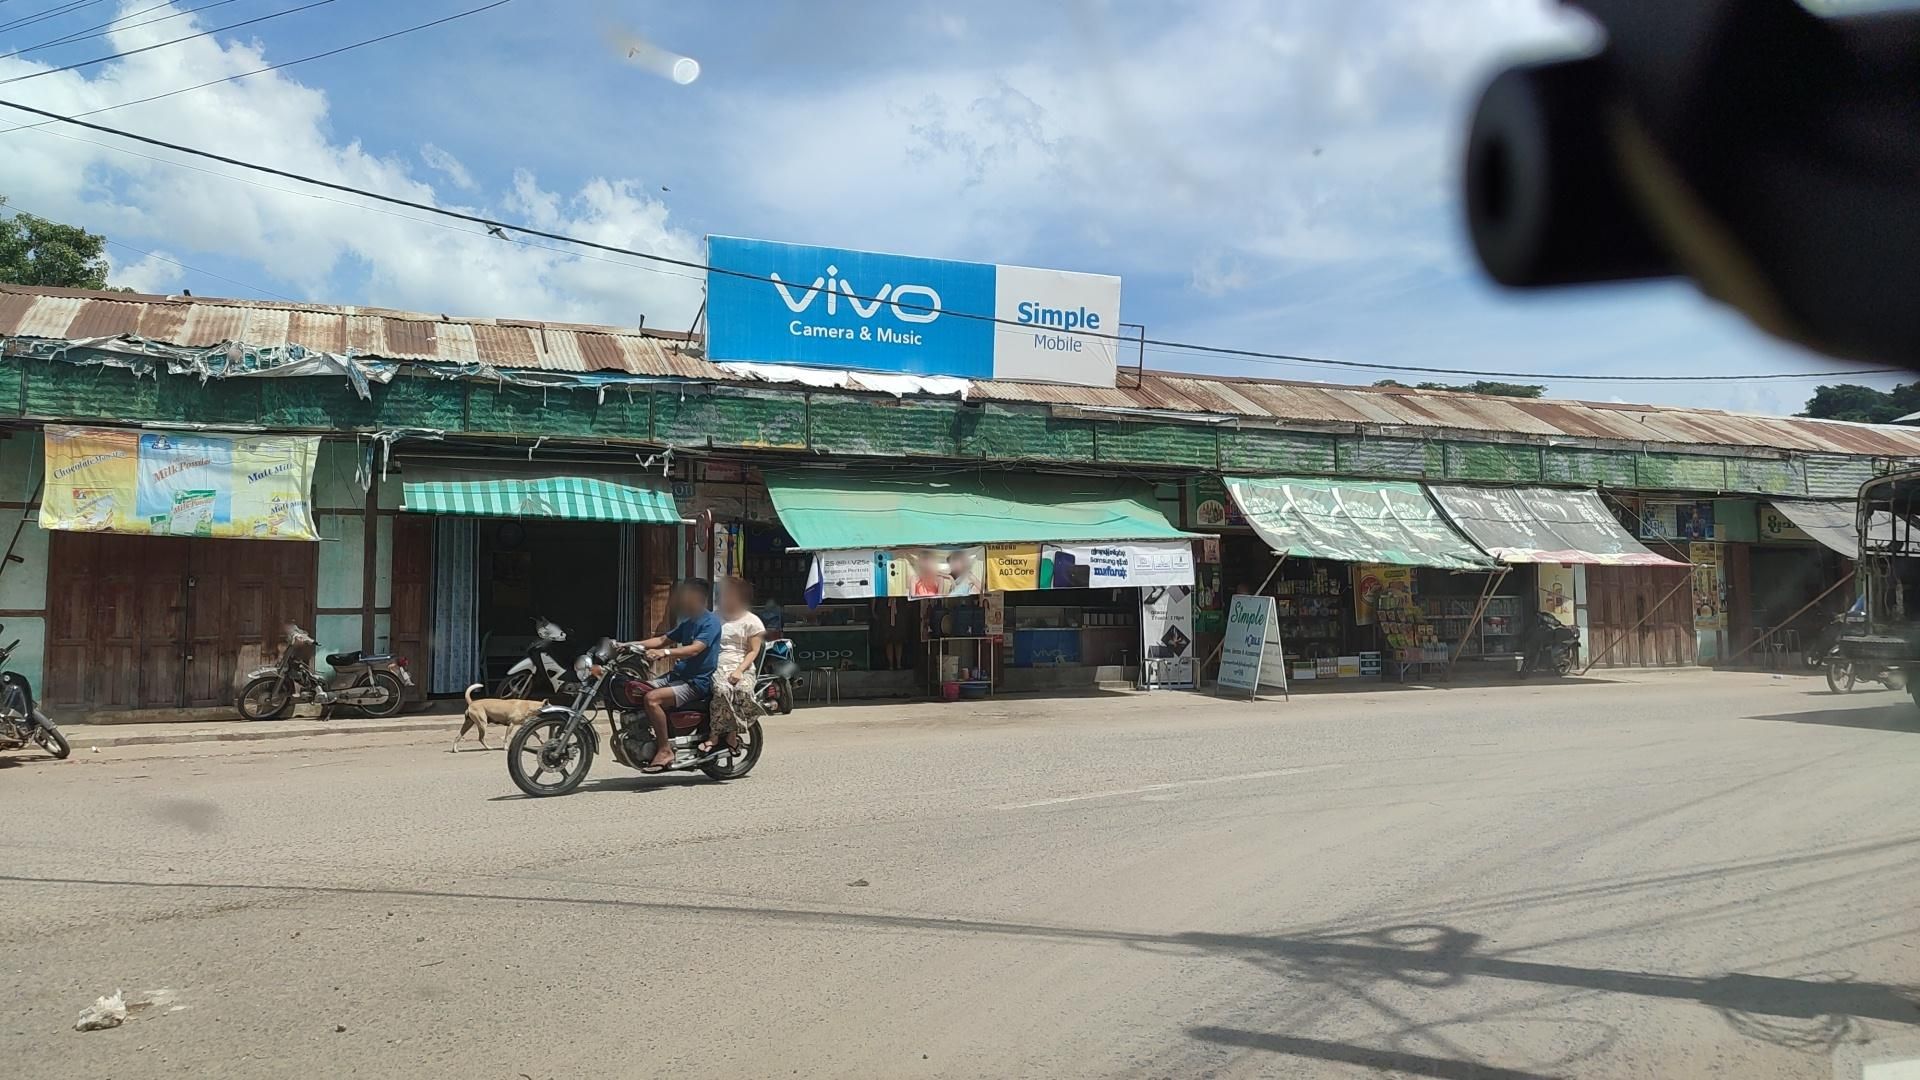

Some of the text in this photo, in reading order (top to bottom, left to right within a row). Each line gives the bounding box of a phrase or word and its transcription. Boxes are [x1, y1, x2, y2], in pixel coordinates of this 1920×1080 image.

[771, 264, 941, 324] vivo
[1017, 302, 1100, 331] Simple
[789, 320, 922, 346] Camera & Music
[1034, 334, 1082, 353] Mobile
[53, 458, 95, 480] Chocolate
[152, 463, 178, 483] Milk
[998, 558, 1028, 567] Galaxy
[999, 567, 1035, 576] A03 Core
[1090, 556, 1116, 566] Samsung
[1230, 601, 1265, 631] Simple
